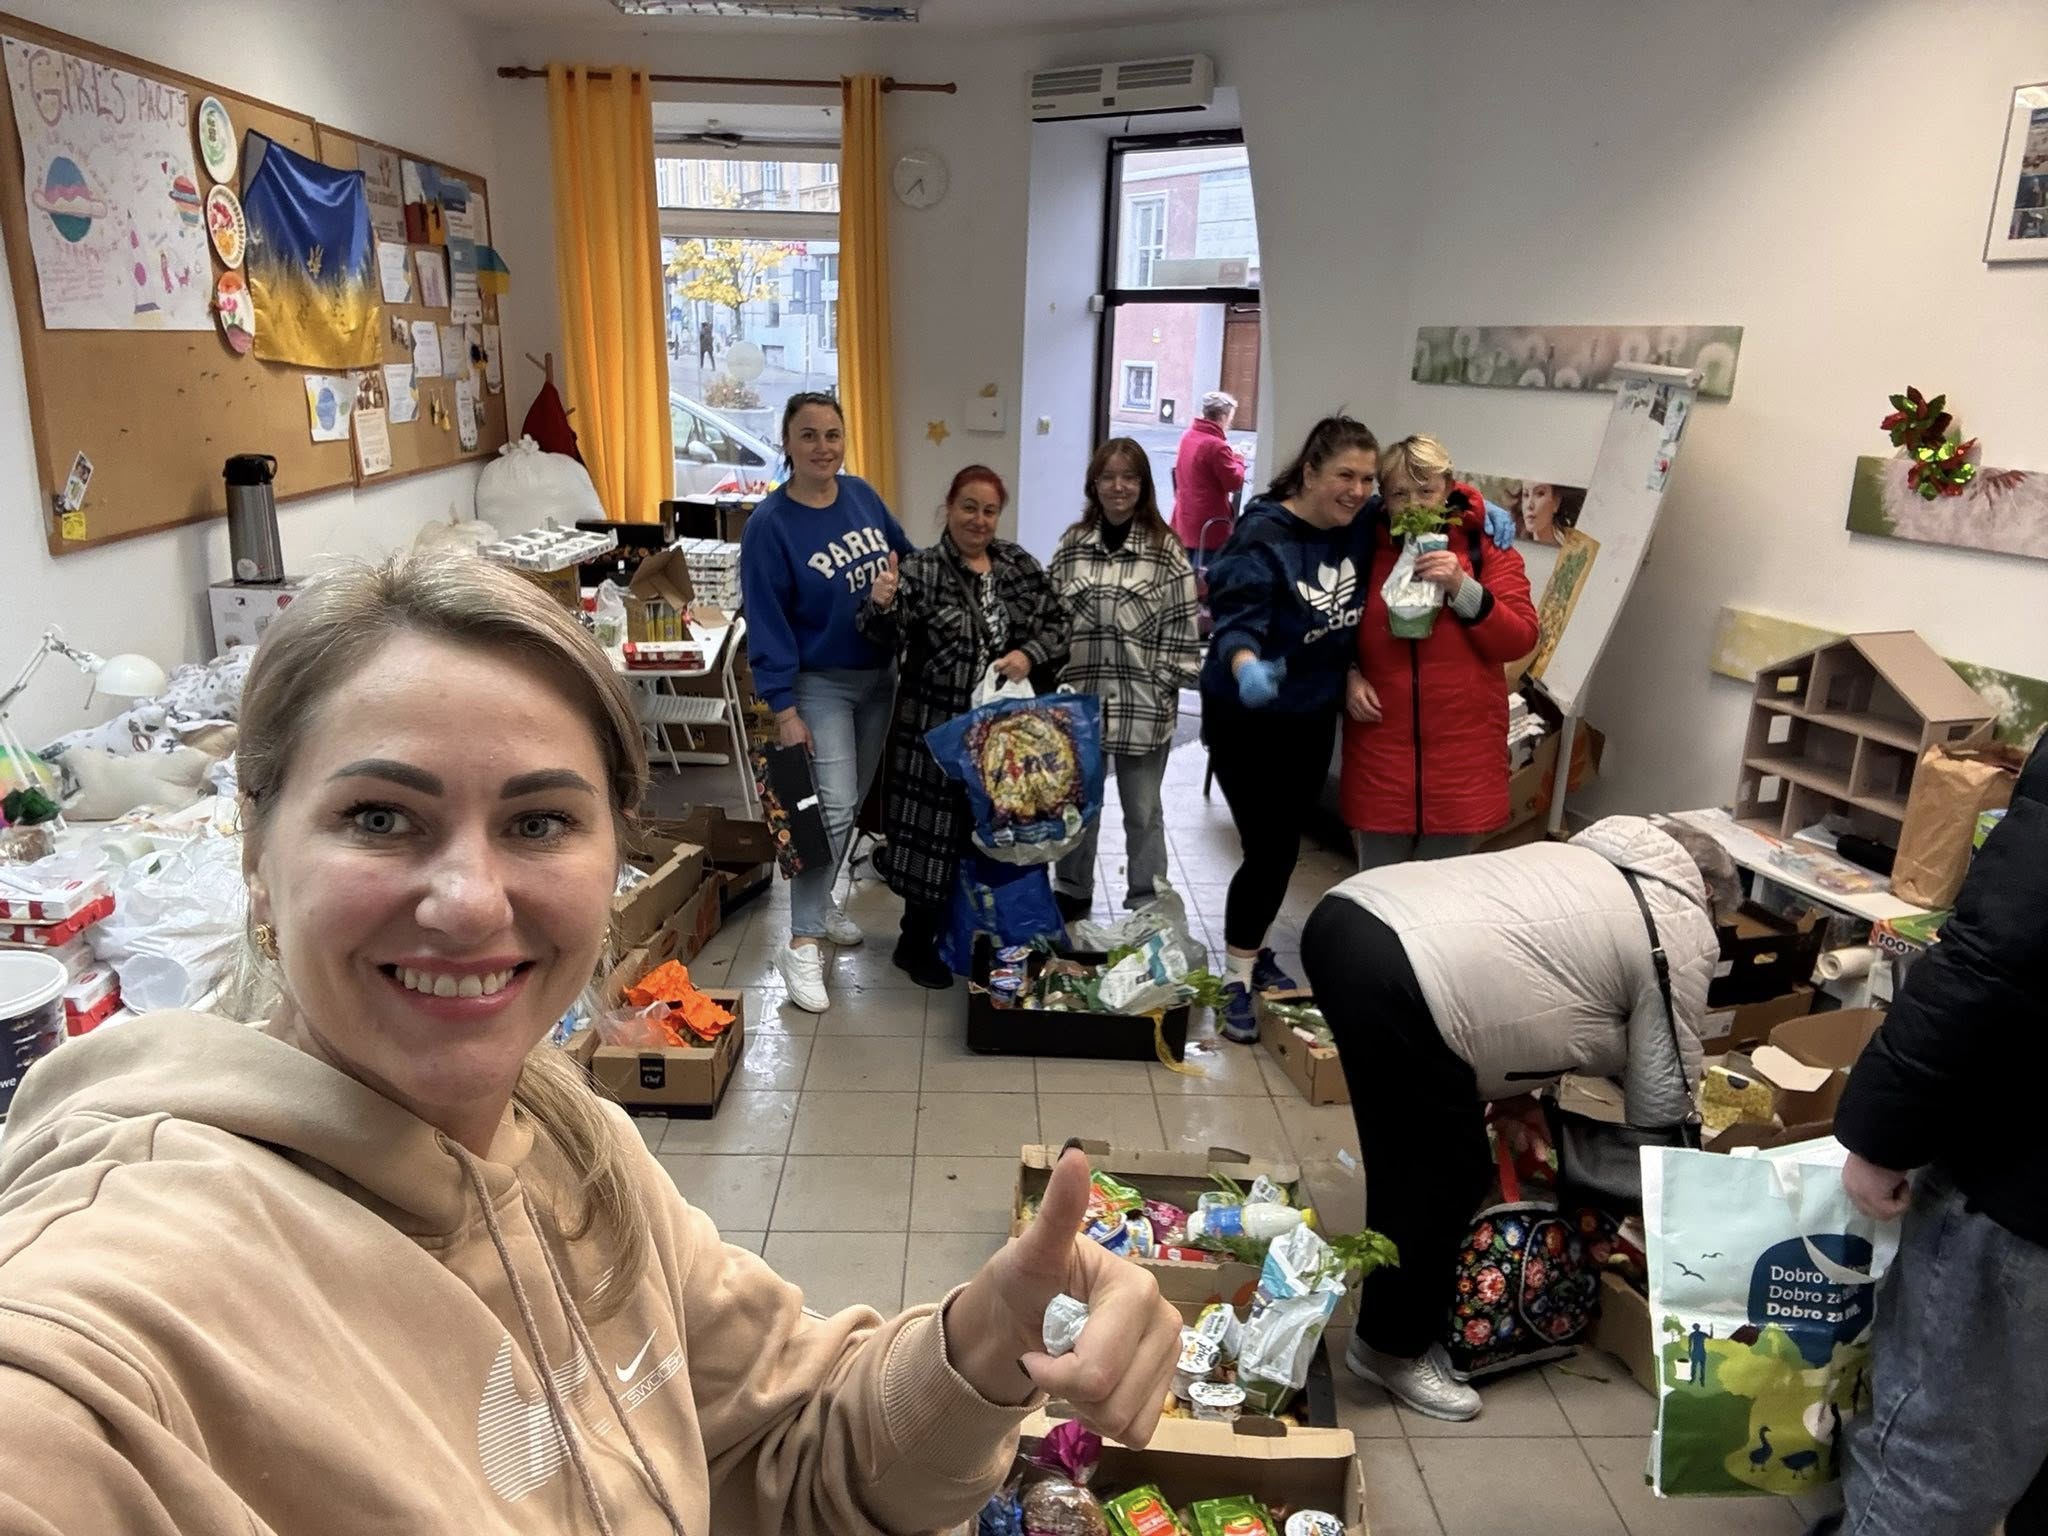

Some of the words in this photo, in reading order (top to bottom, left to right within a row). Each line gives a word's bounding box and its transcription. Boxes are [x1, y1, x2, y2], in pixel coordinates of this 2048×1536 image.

[807, 526, 890, 579] PARIS
[845, 556, 890, 594] 1970
[1770, 1265, 1823, 1284] Dobro
[1769, 1285, 1823, 1303] Dobro
[1766, 1302, 1823, 1320] Dobro
